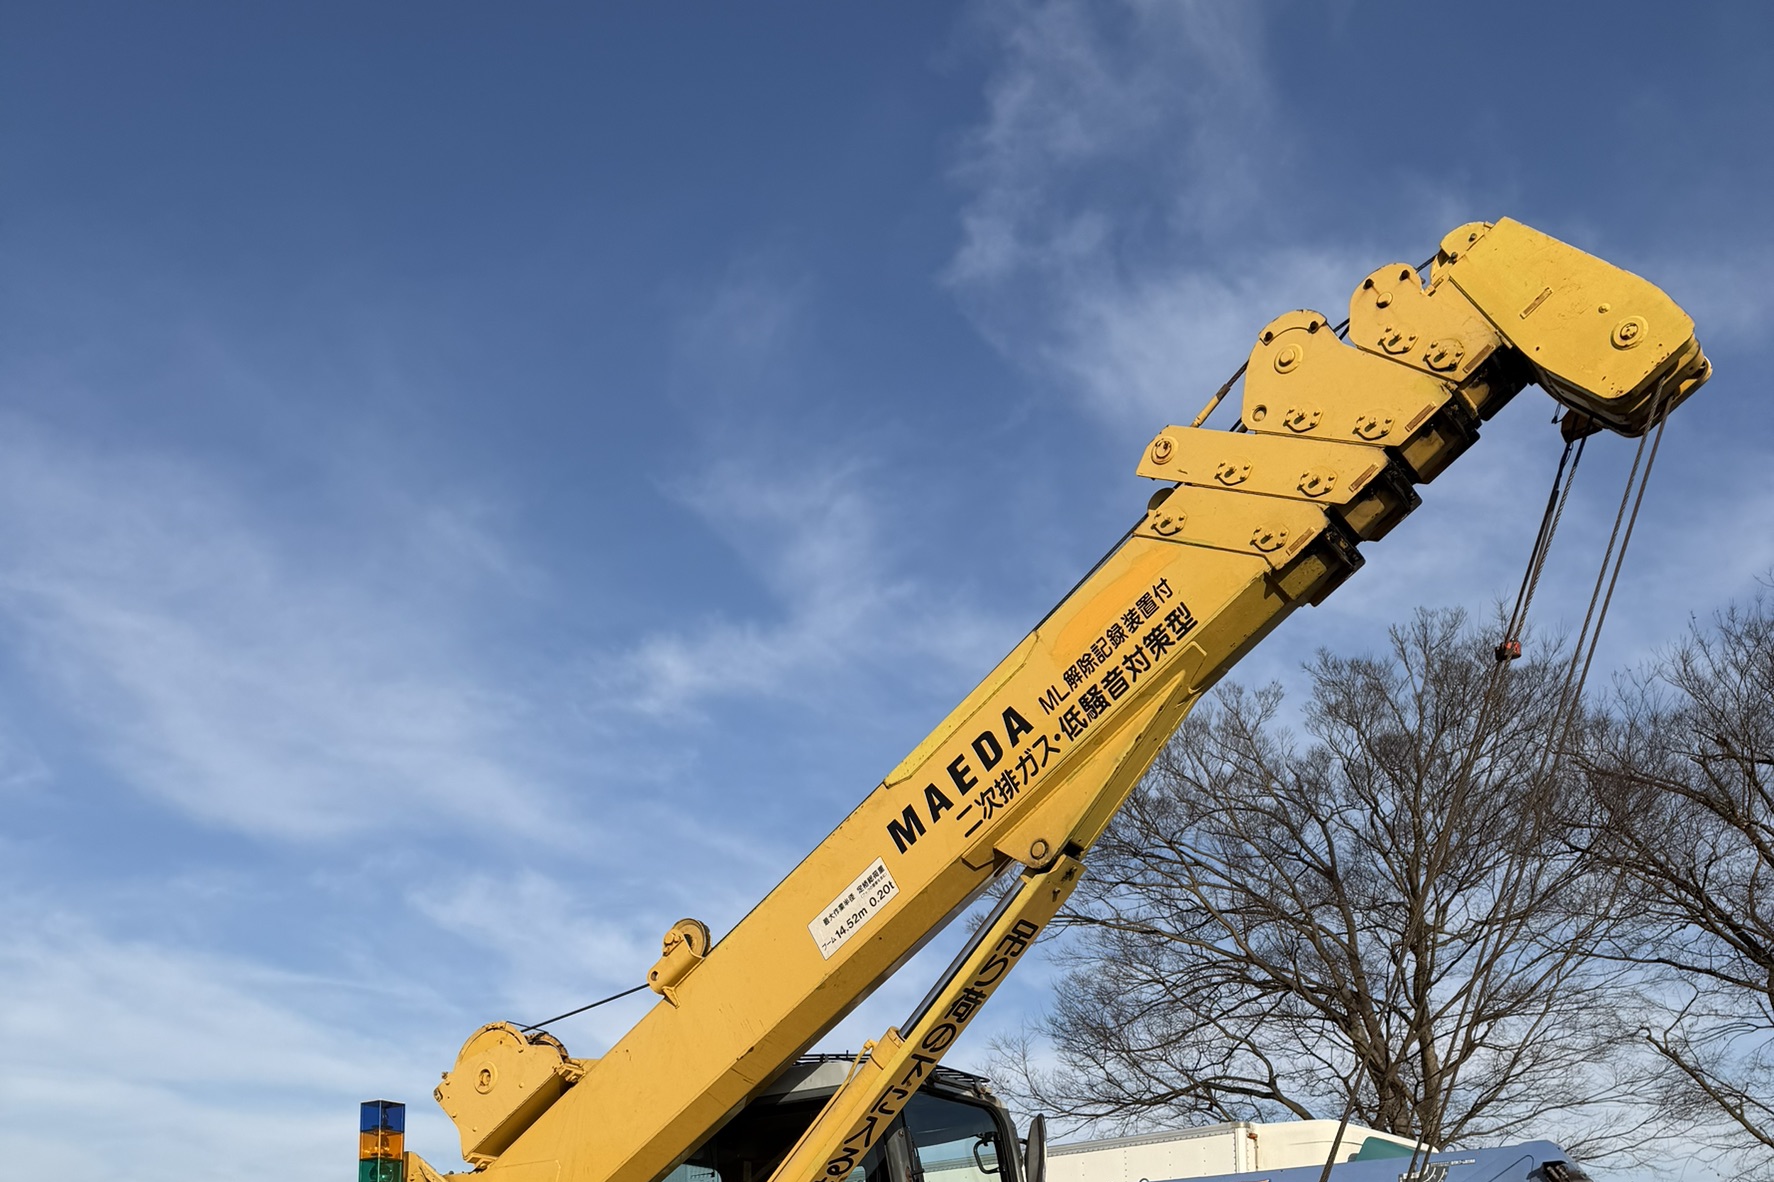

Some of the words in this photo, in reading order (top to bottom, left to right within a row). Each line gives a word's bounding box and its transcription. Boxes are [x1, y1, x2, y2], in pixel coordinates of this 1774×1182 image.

[1038, 577, 1174, 715] ML解除記録装置付
[886, 705, 1035, 855] MAEDA
[956, 601, 1198, 838] 二次排ガス・低騒音対策型
[835, 907, 869, 939] 14.52m
[868, 880, 895, 907] 0.20t
